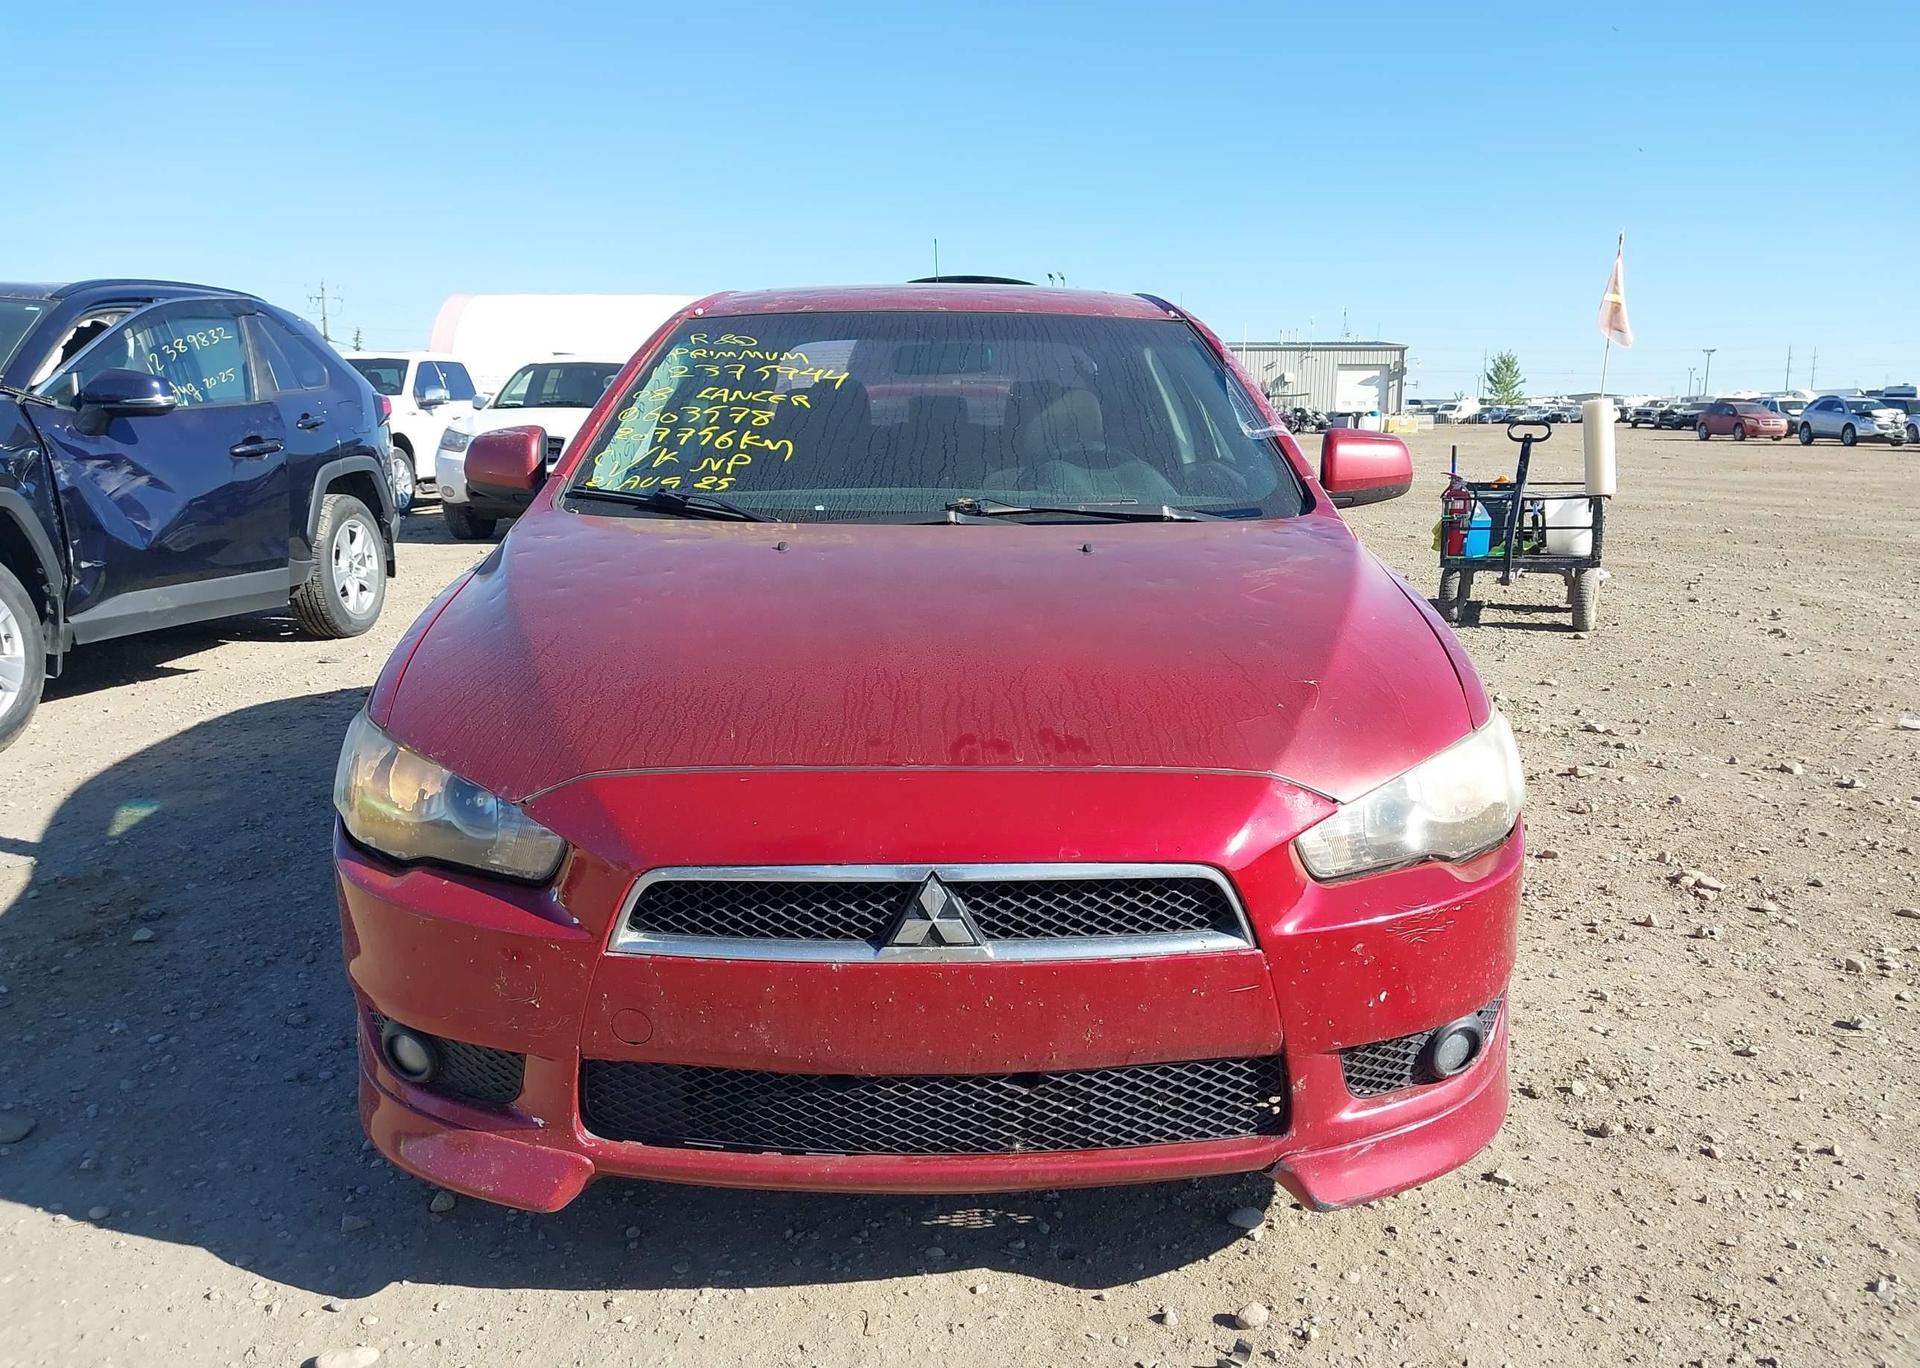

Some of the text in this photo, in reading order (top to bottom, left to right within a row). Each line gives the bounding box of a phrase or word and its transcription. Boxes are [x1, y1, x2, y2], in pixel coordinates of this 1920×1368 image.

[146, 327, 233, 375] 12389832
[696, 387, 811, 409] LANCER
[693, 475, 737, 491] 25
